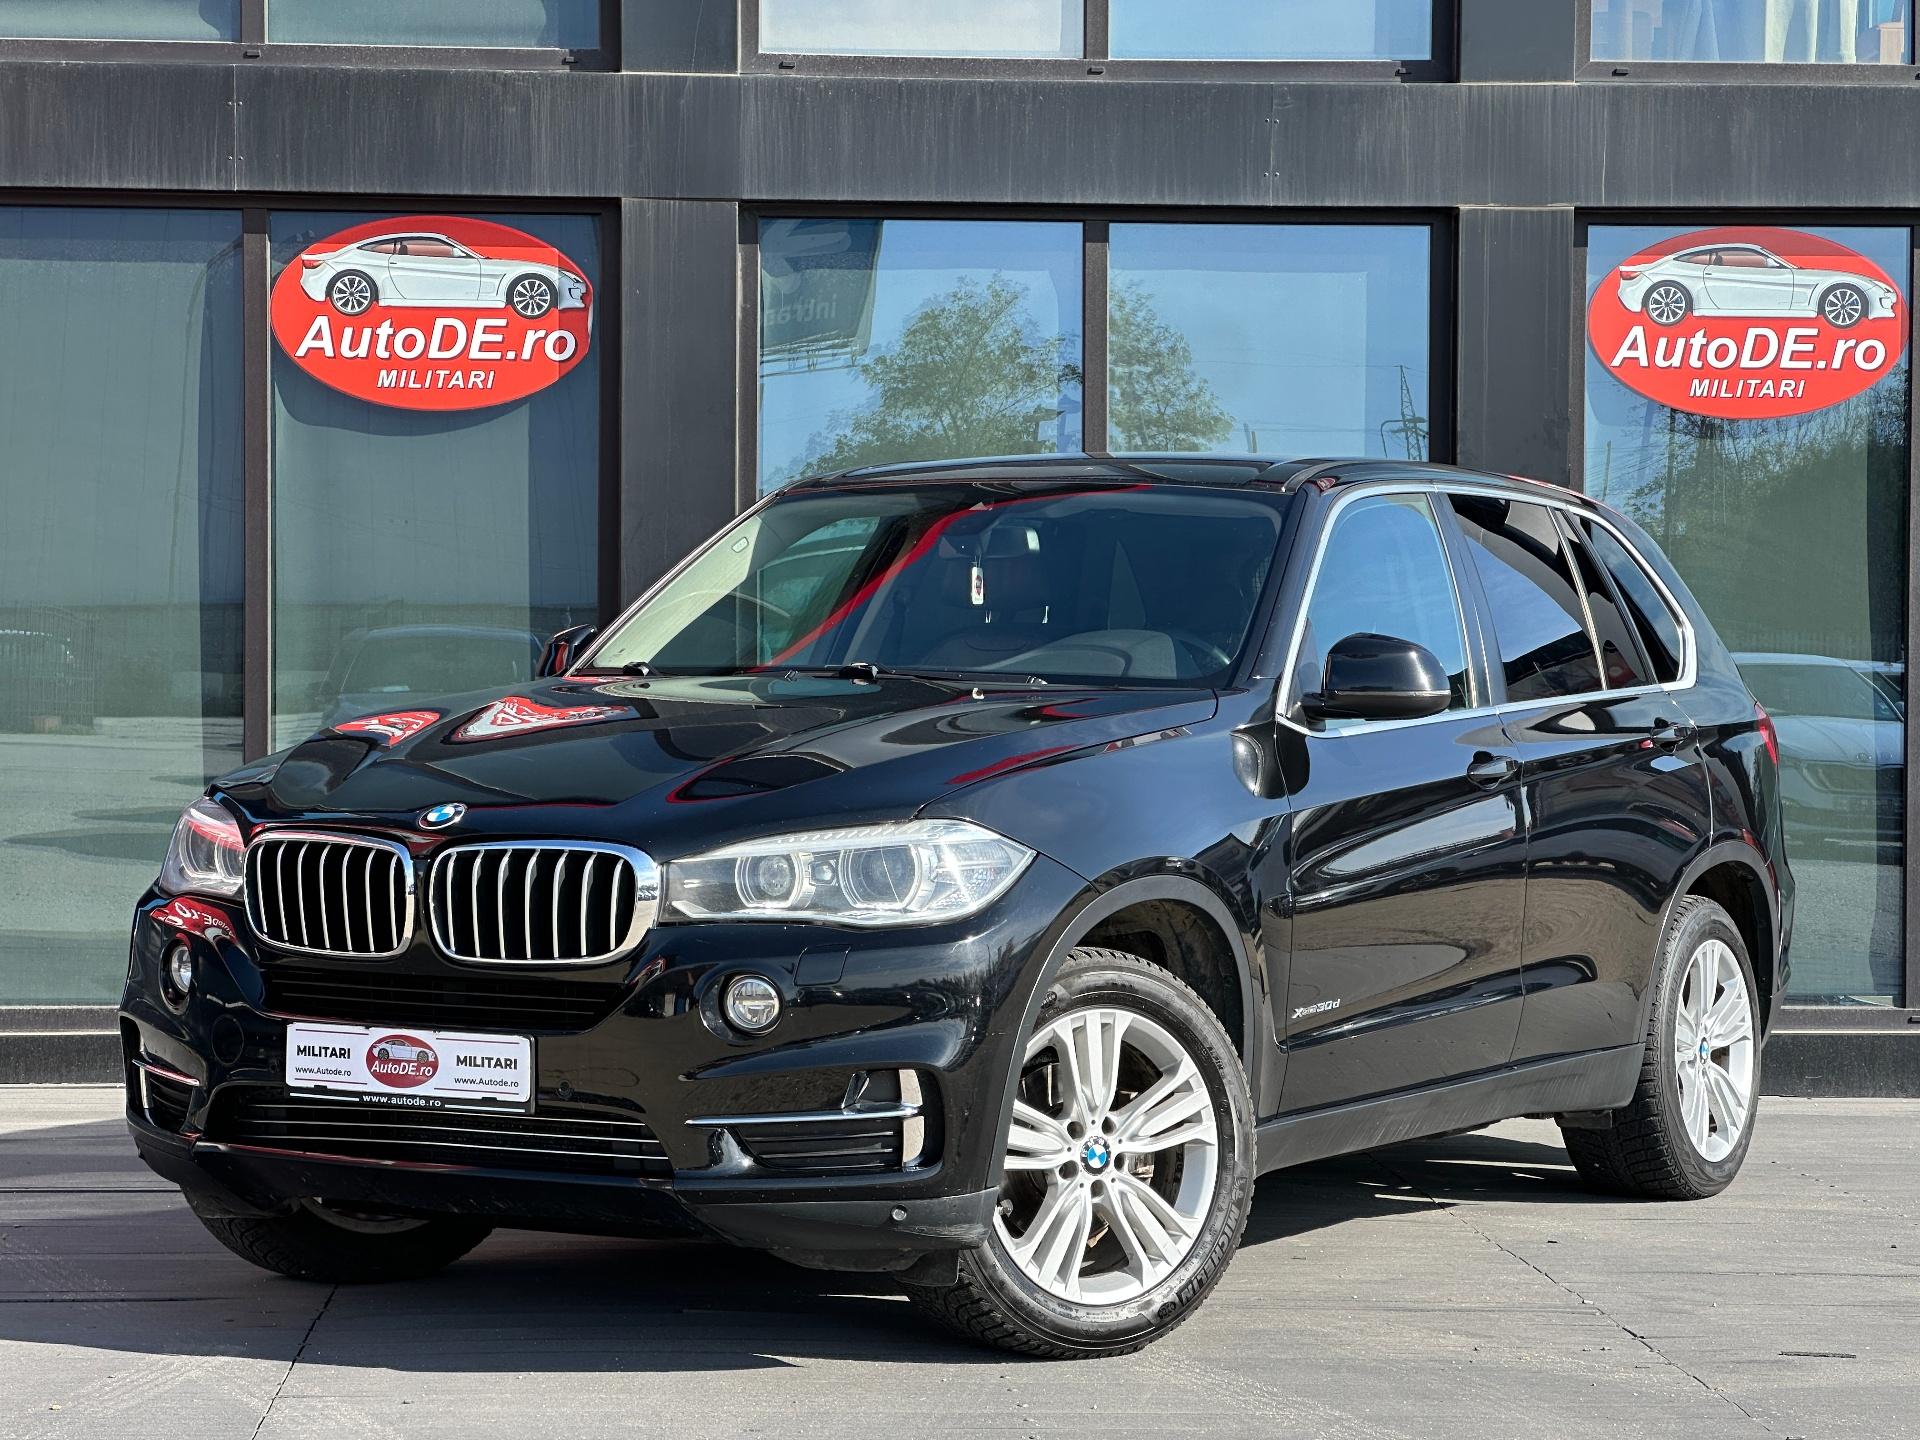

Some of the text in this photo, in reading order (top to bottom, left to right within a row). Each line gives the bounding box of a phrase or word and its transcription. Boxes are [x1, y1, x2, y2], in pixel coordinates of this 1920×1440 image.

[294, 315, 577, 362] AutoDE.ro
[1610, 324, 1887, 371] AutoDE.ro
[376, 369, 495, 390] MILITARI
[1688, 379, 1806, 399] MILITARI
[296, 1044, 351, 1060] MILITARI
[295, 1065, 352, 1077] www.Autode.ro
[371, 1060, 433, 1078] AutoDE.ro
[456, 1054, 518, 1071] MILITARI
[454, 1076, 520, 1088] www.Autode.ro
[362, 1094, 441, 1107] www.autode.ro
[1178, 1203, 1241, 1307] MICHELIN
